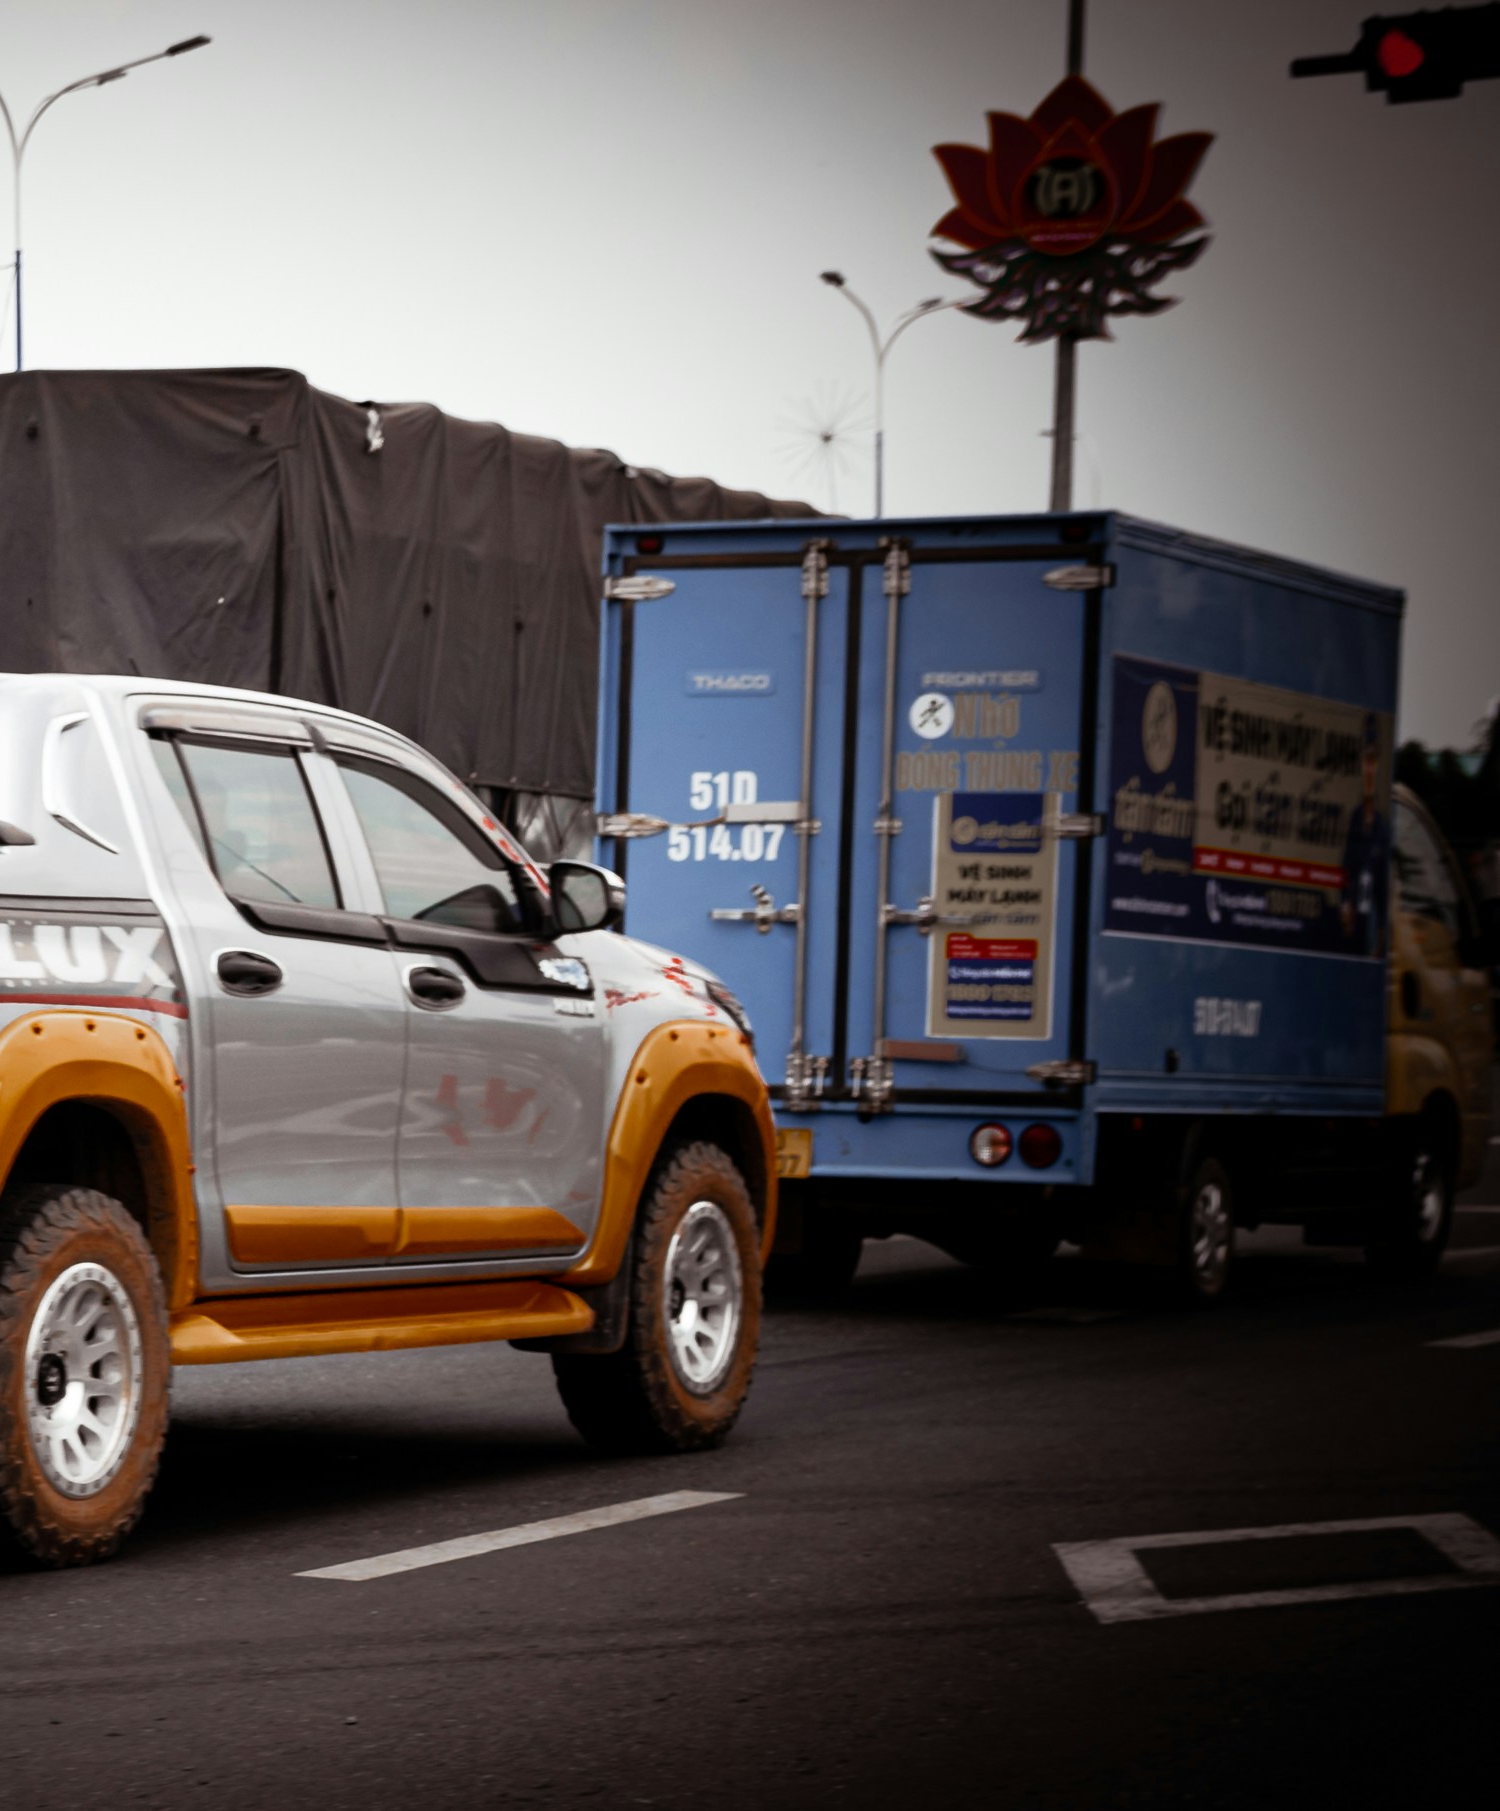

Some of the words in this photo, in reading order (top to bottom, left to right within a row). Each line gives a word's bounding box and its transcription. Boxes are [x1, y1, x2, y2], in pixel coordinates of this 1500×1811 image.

[693, 674, 770, 690] THACO
[922, 670, 1039, 688] FRONTIER
[690, 770, 758, 811] 51D
[666, 823, 786, 862] 514.07
